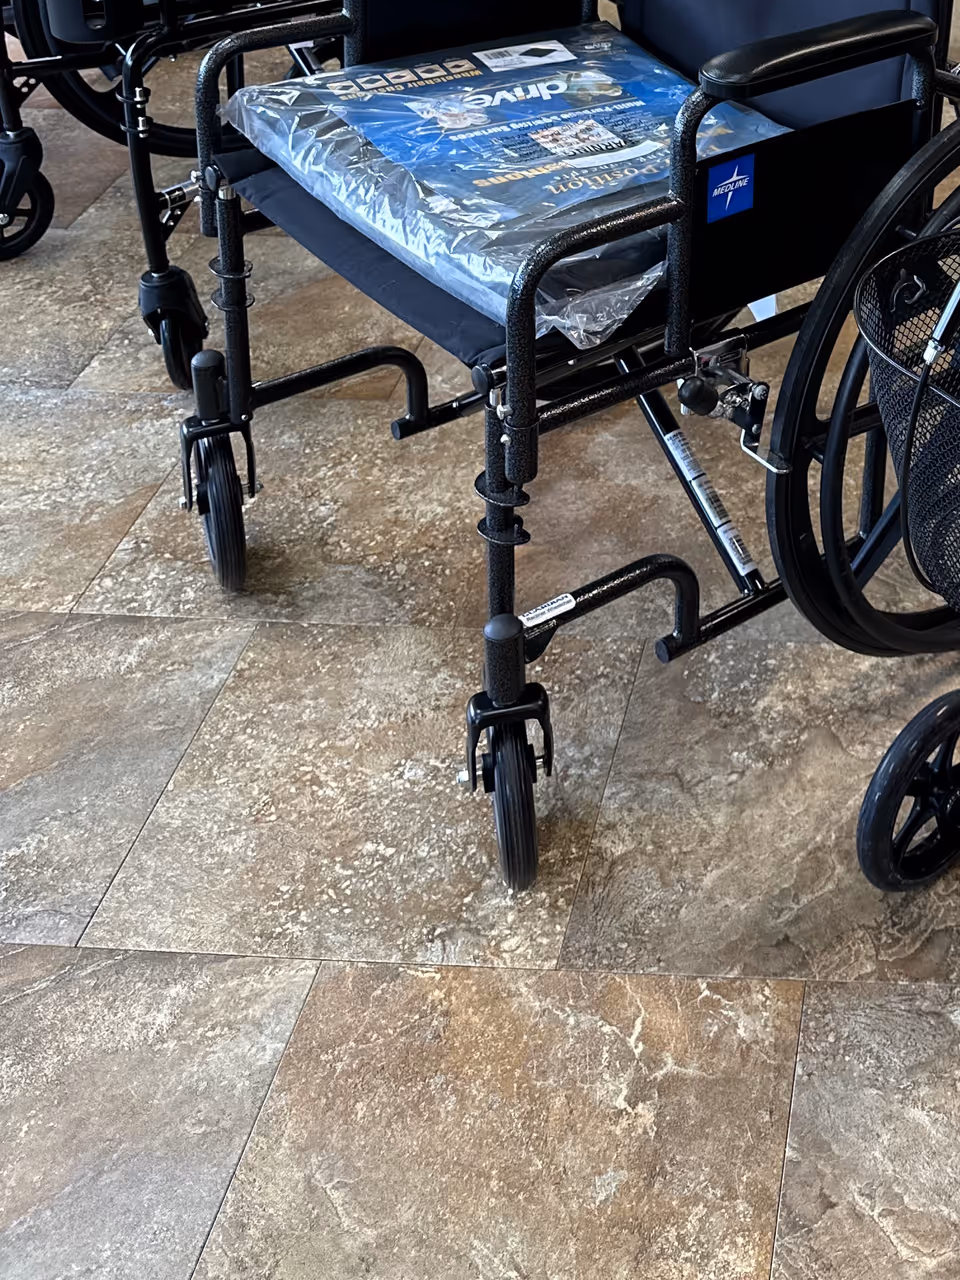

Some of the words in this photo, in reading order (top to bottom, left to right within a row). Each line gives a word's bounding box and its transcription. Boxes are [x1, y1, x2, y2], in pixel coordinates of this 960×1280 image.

[406, 69, 484, 89] Wheelchair
[339, 84, 405, 101] Cushons
[462, 79, 569, 108] drive
[711, 177, 751, 198] MEDLINE
